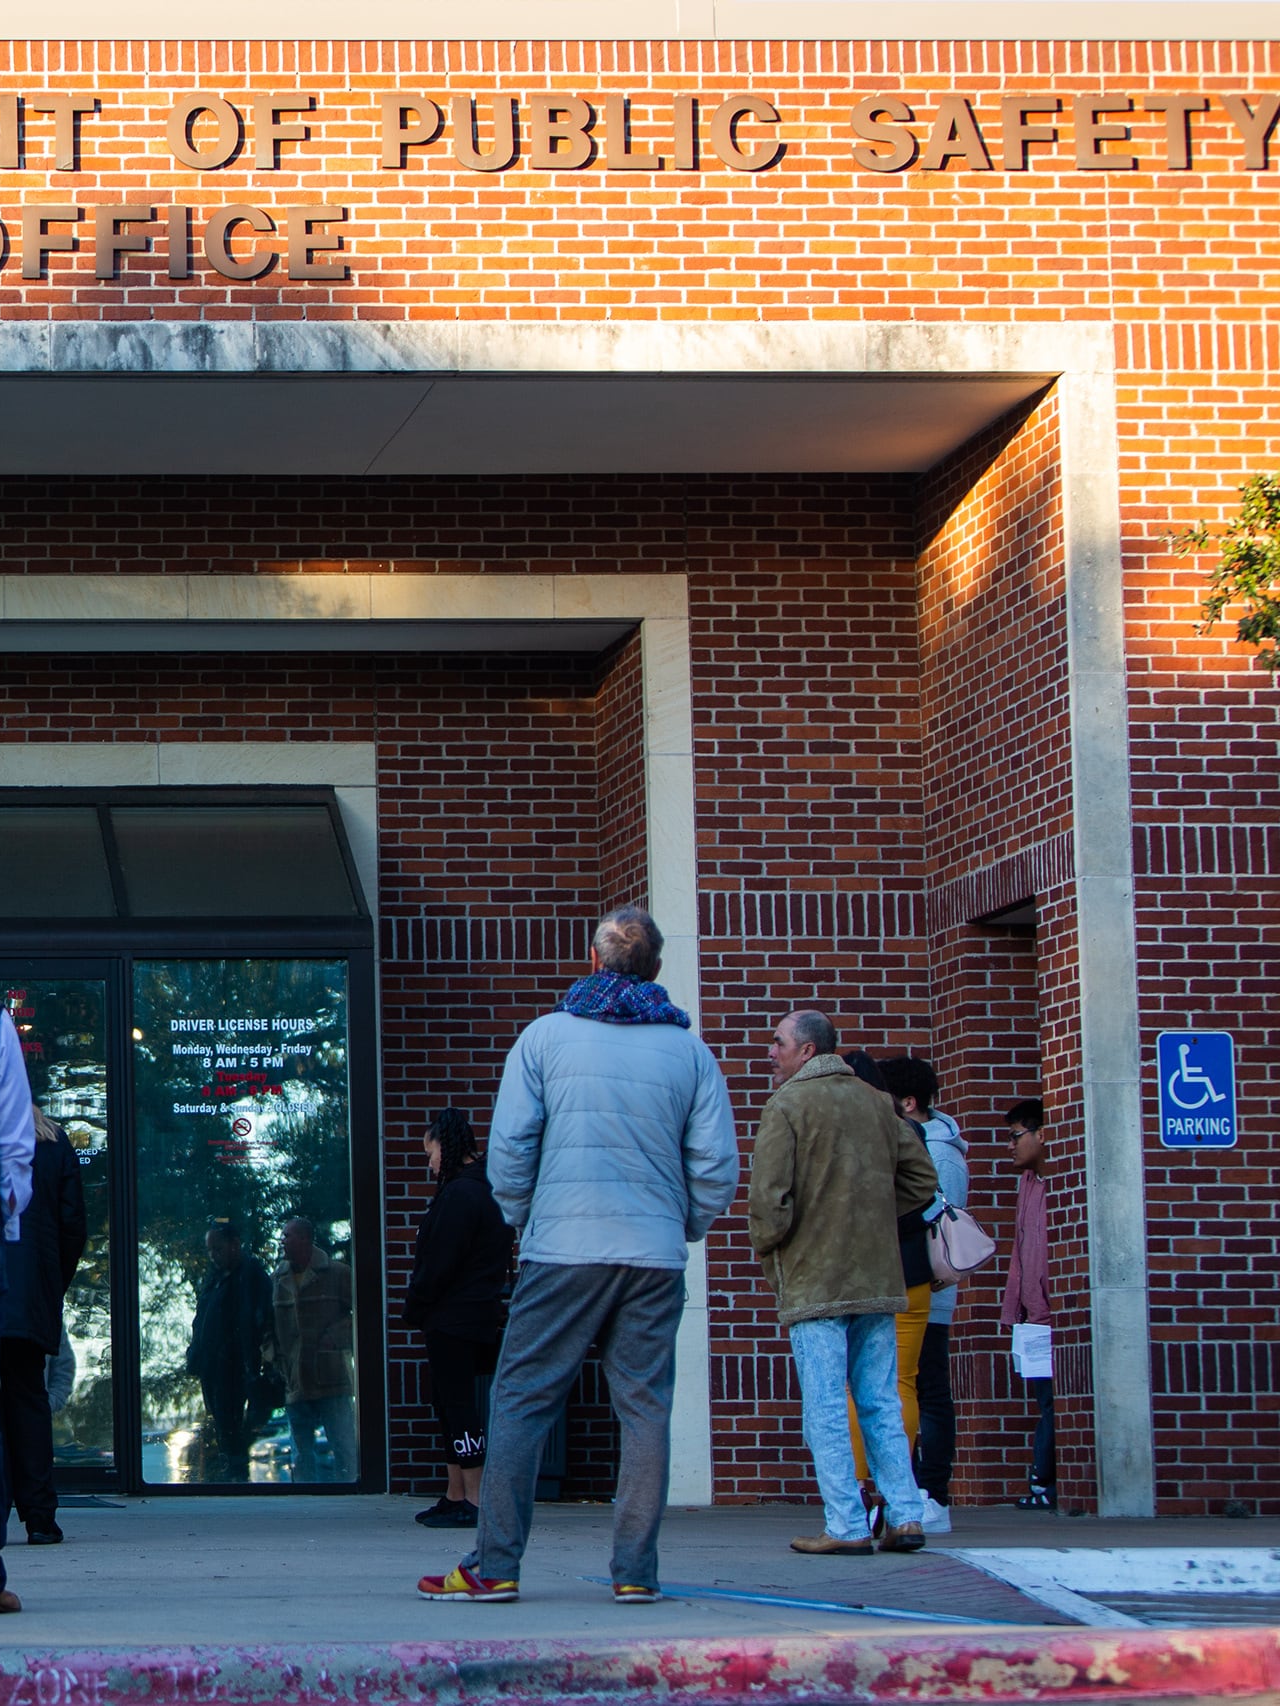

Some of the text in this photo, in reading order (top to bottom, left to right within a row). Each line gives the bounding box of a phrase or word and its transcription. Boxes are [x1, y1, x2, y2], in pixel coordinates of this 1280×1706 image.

[166, 93, 312, 170] OF
[382, 94, 784, 171] PUBLIC
[850, 94, 1280, 171] SAFETY
[8, 1007, 35, 1017] OOD
[170, 1018, 313, 1032] DRIVER LICENSE HOURS
[172, 1044, 214, 1057] Monday,
[216, 1043, 272, 1056] Wednesday
[281, 1043, 312, 1055] Friday
[202, 1058, 211, 1068] 8
[215, 1057, 237, 1068] AM
[249, 1057, 259, 1068] 5
[263, 1057, 284, 1068] PM
[216, 1071, 268, 1084] Tuesday
[214, 1085, 237, 1096] AM
[261, 1085, 283, 1095] PM
[173, 1103, 217, 1115] Saturday
[220, 1103, 228, 1113] &
[230, 1103, 264, 1115] Sunday
[274, 1102, 316, 1113] CLOSED
[1166, 1117, 1231, 1136] PARKING
[75, 1148, 98, 1156] CKED
